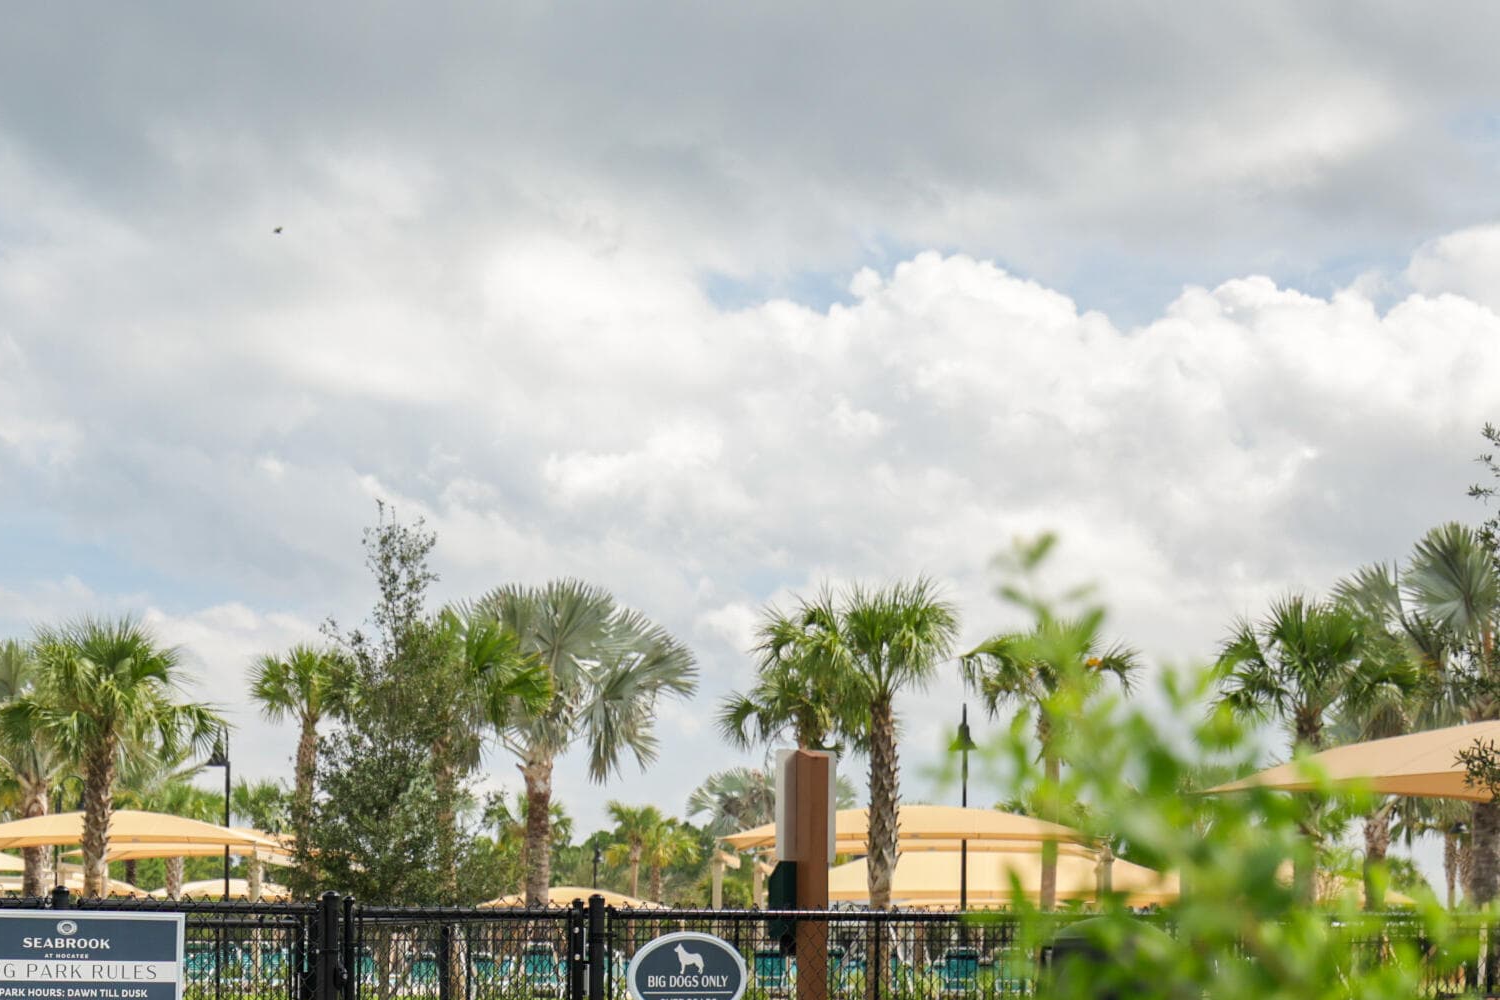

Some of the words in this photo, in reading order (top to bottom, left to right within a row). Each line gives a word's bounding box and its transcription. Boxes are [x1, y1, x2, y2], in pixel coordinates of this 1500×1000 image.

[23, 938, 110, 949] SEABROOK
[26, 964, 82, 979] PARK
[92, 964, 157, 980] RULES
[648, 976, 666, 987] BIG
[669, 976, 699, 987] DOGS
[701, 976, 728, 987] ONLY
[28, 988, 65, 997] HOURS:
[68, 989, 97, 997] DAWN
[100, 989, 119, 997] TILL
[122, 989, 148, 997] DUSK
